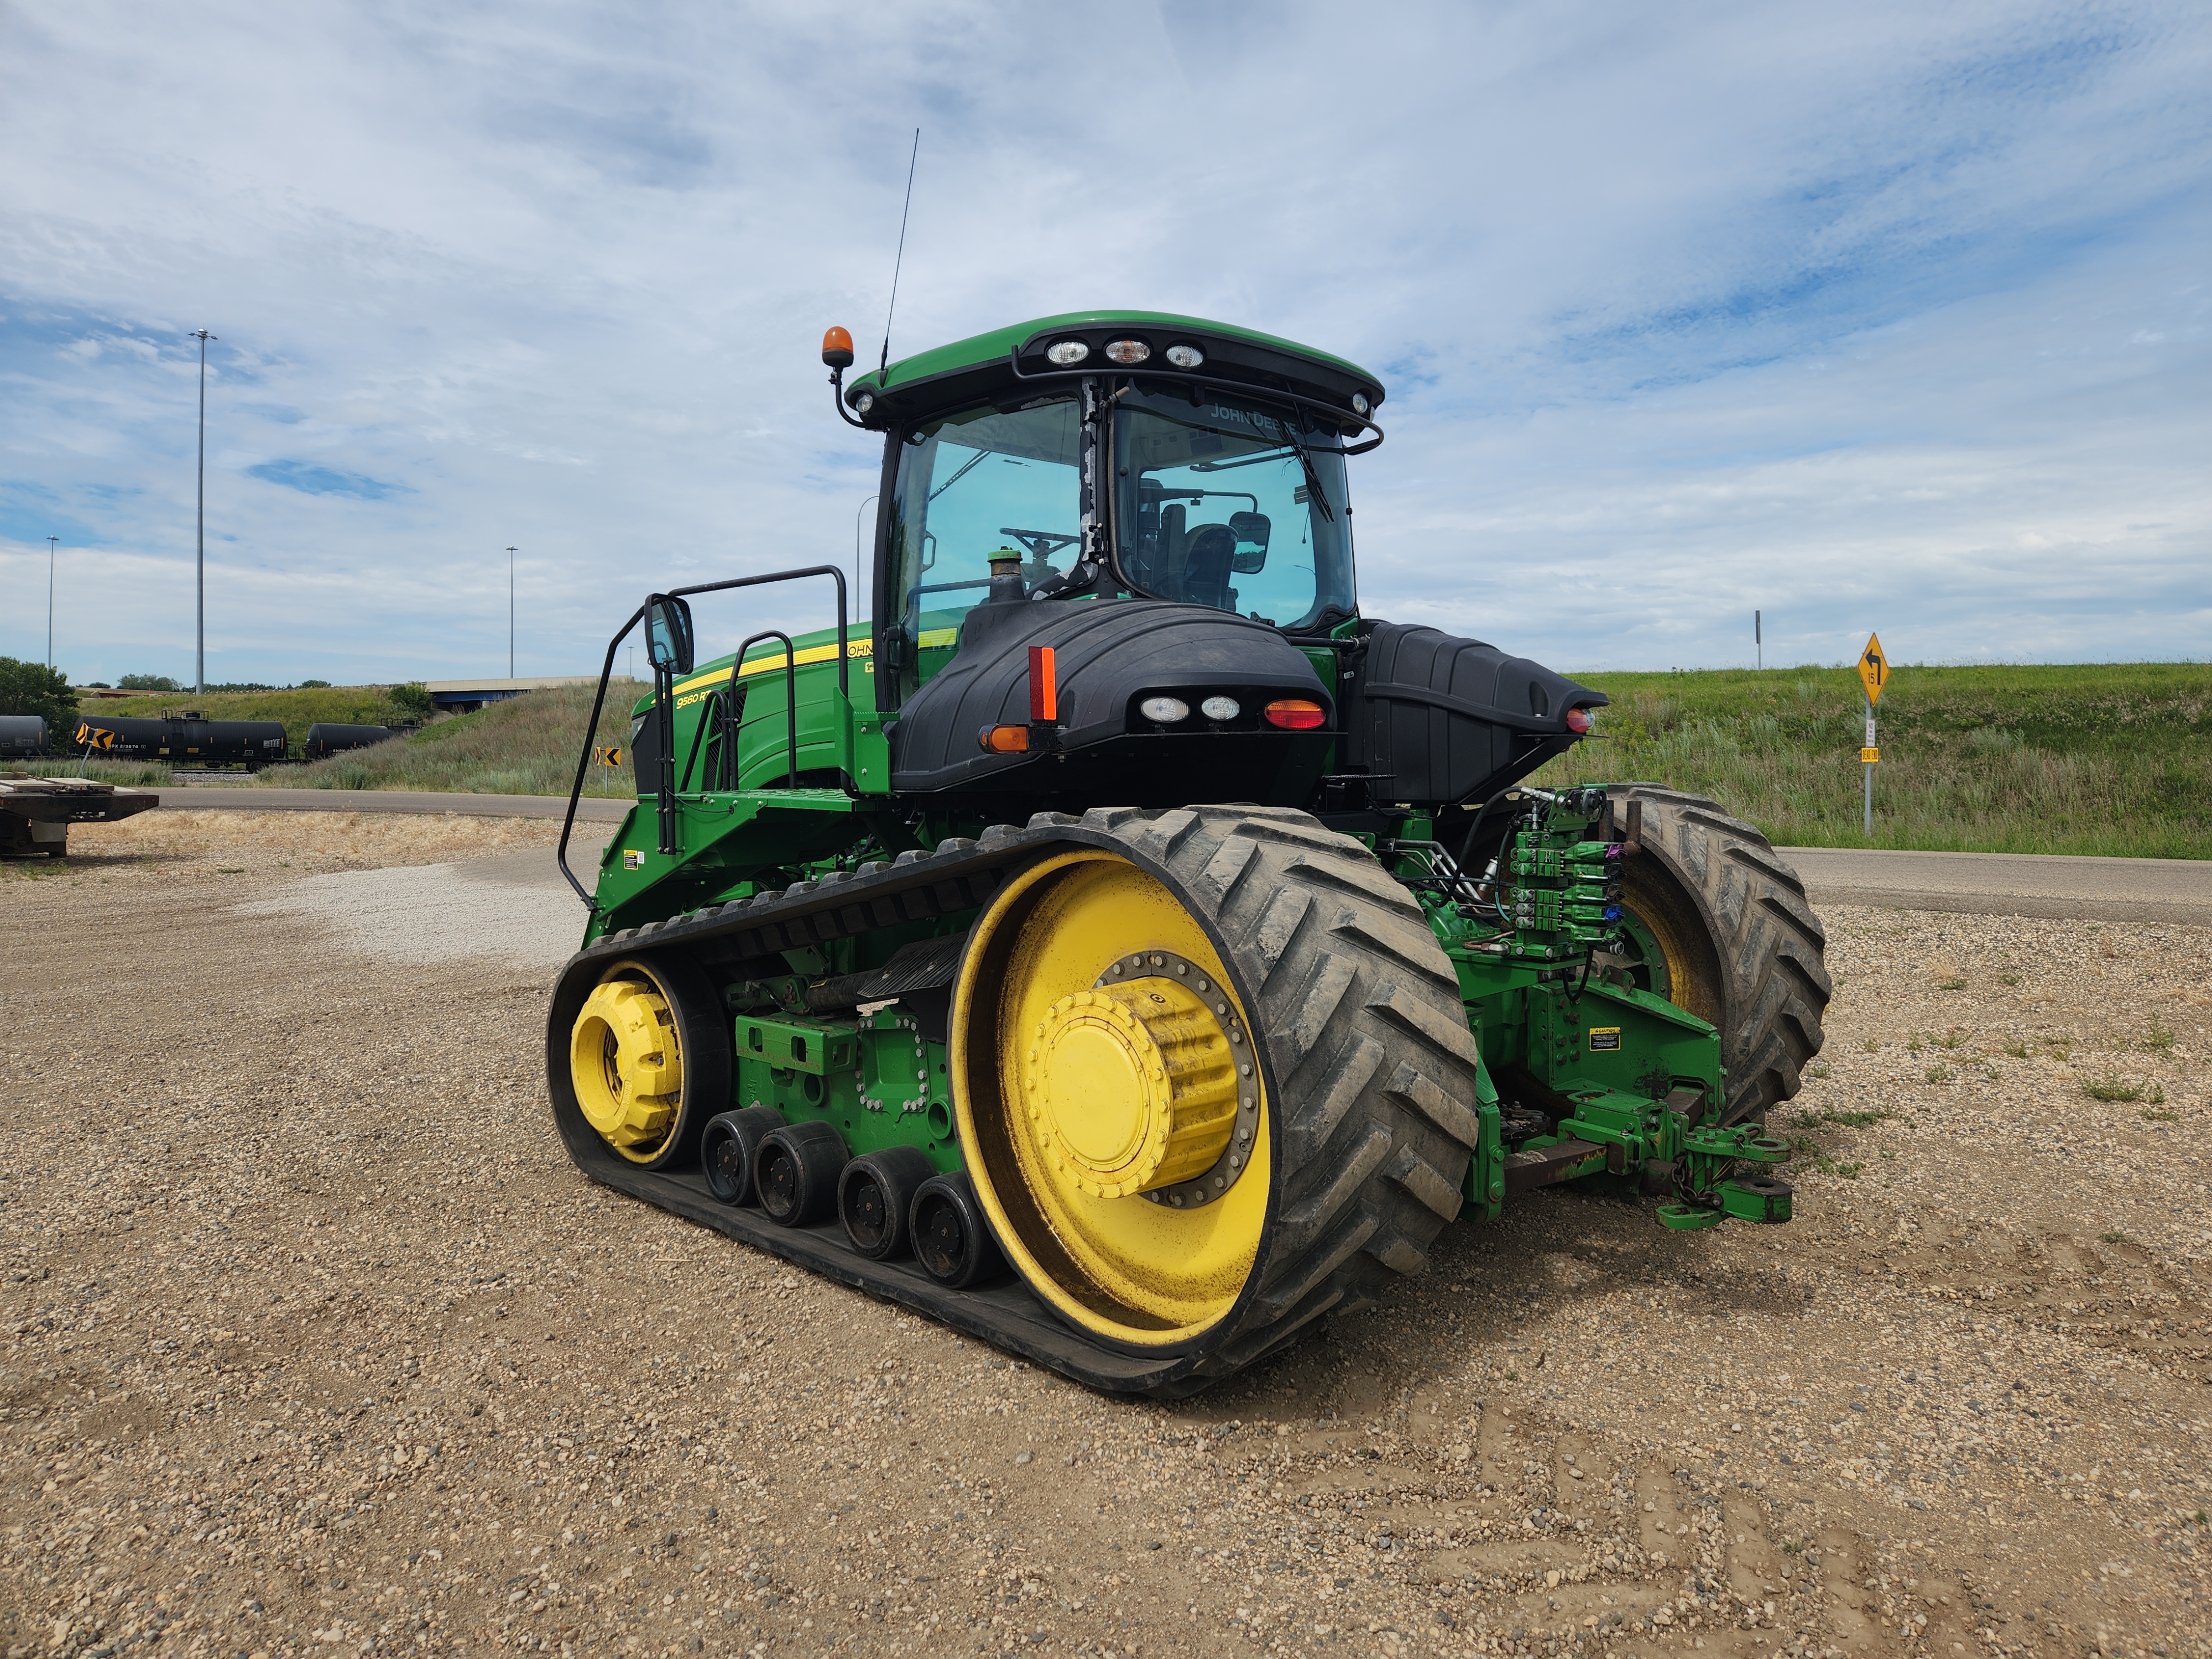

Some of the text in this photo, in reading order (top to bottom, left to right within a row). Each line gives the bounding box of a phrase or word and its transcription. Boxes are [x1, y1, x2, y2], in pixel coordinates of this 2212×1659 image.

[1211, 403, 1250, 424] JOHN
[848, 644, 873, 656] OHN
[1868, 672, 1875, 684] 15
[676, 693, 699, 709] 9560
